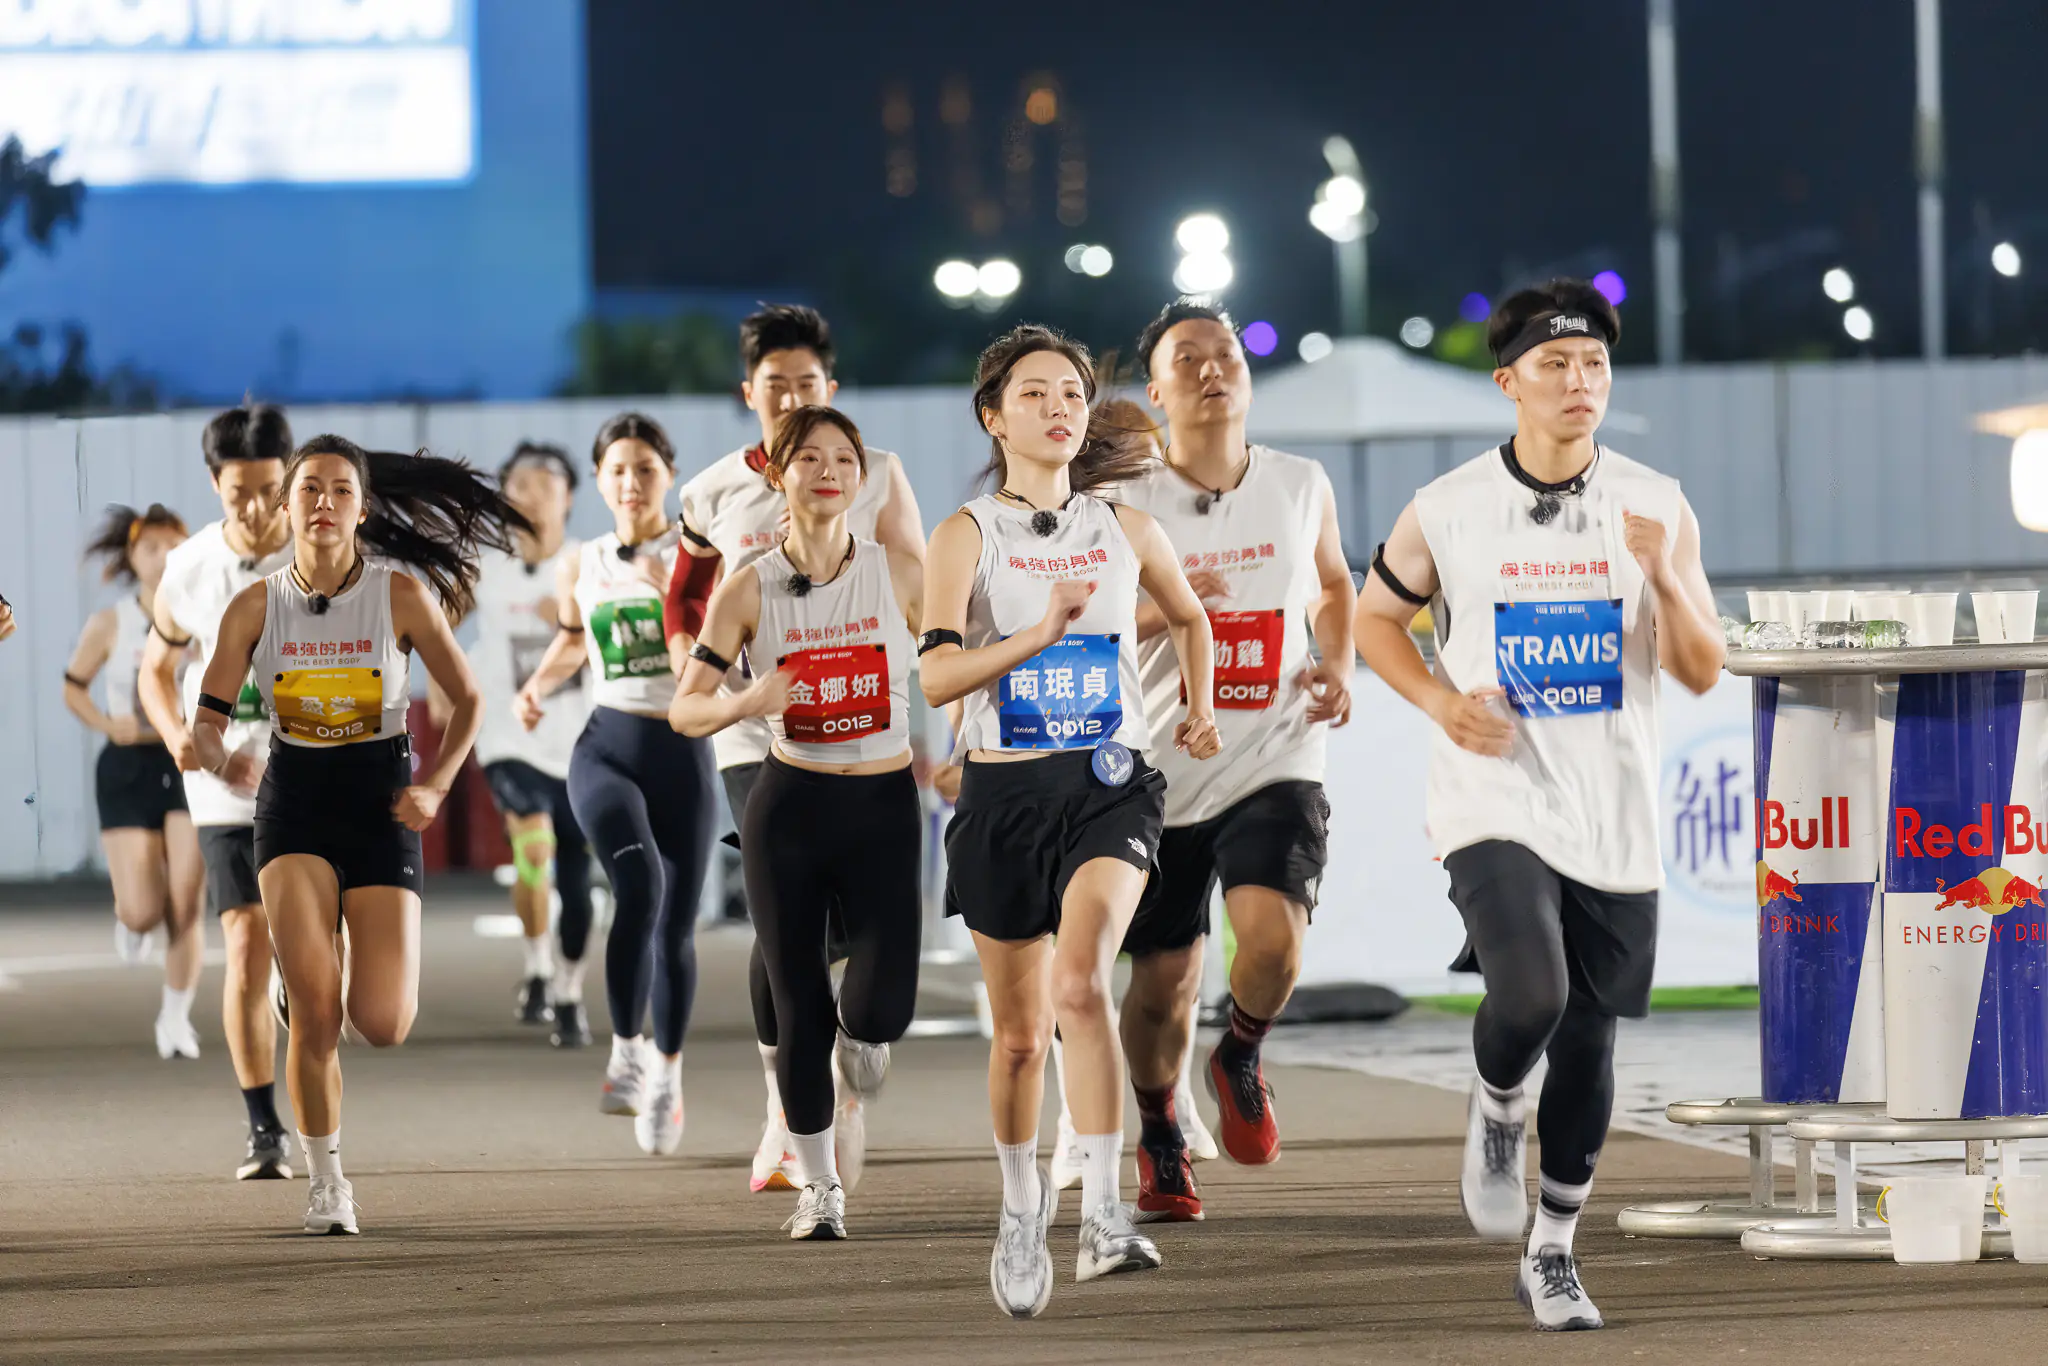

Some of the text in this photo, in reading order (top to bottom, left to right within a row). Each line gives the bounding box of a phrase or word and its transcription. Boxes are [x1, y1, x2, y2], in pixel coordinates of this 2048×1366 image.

[1008, 548, 1108, 573] 最強的身體
[785, 616, 879, 643] 最強的身體
[281, 639, 373, 657] 最強的身體
[1501, 632, 1618, 666] TRAVIS
[312, 658, 335, 666] BEST
[338, 657, 361, 665] BODY
[788, 672, 880, 705] 金娜妍
[1009, 665, 1109, 701] 南珉貞
[1218, 684, 1270, 701] 0012
[1543, 684, 1602, 706] 0012
[316, 721, 364, 738] 0012
[822, 714, 873, 734] 0012
[1045, 719, 1103, 738] 0012
[1764, 796, 1850, 850] Bull
[1895, 803, 1993, 859] Red
[1771, 915, 1840, 933] DRINK
[1903, 923, 2005, 945] ENERGY
